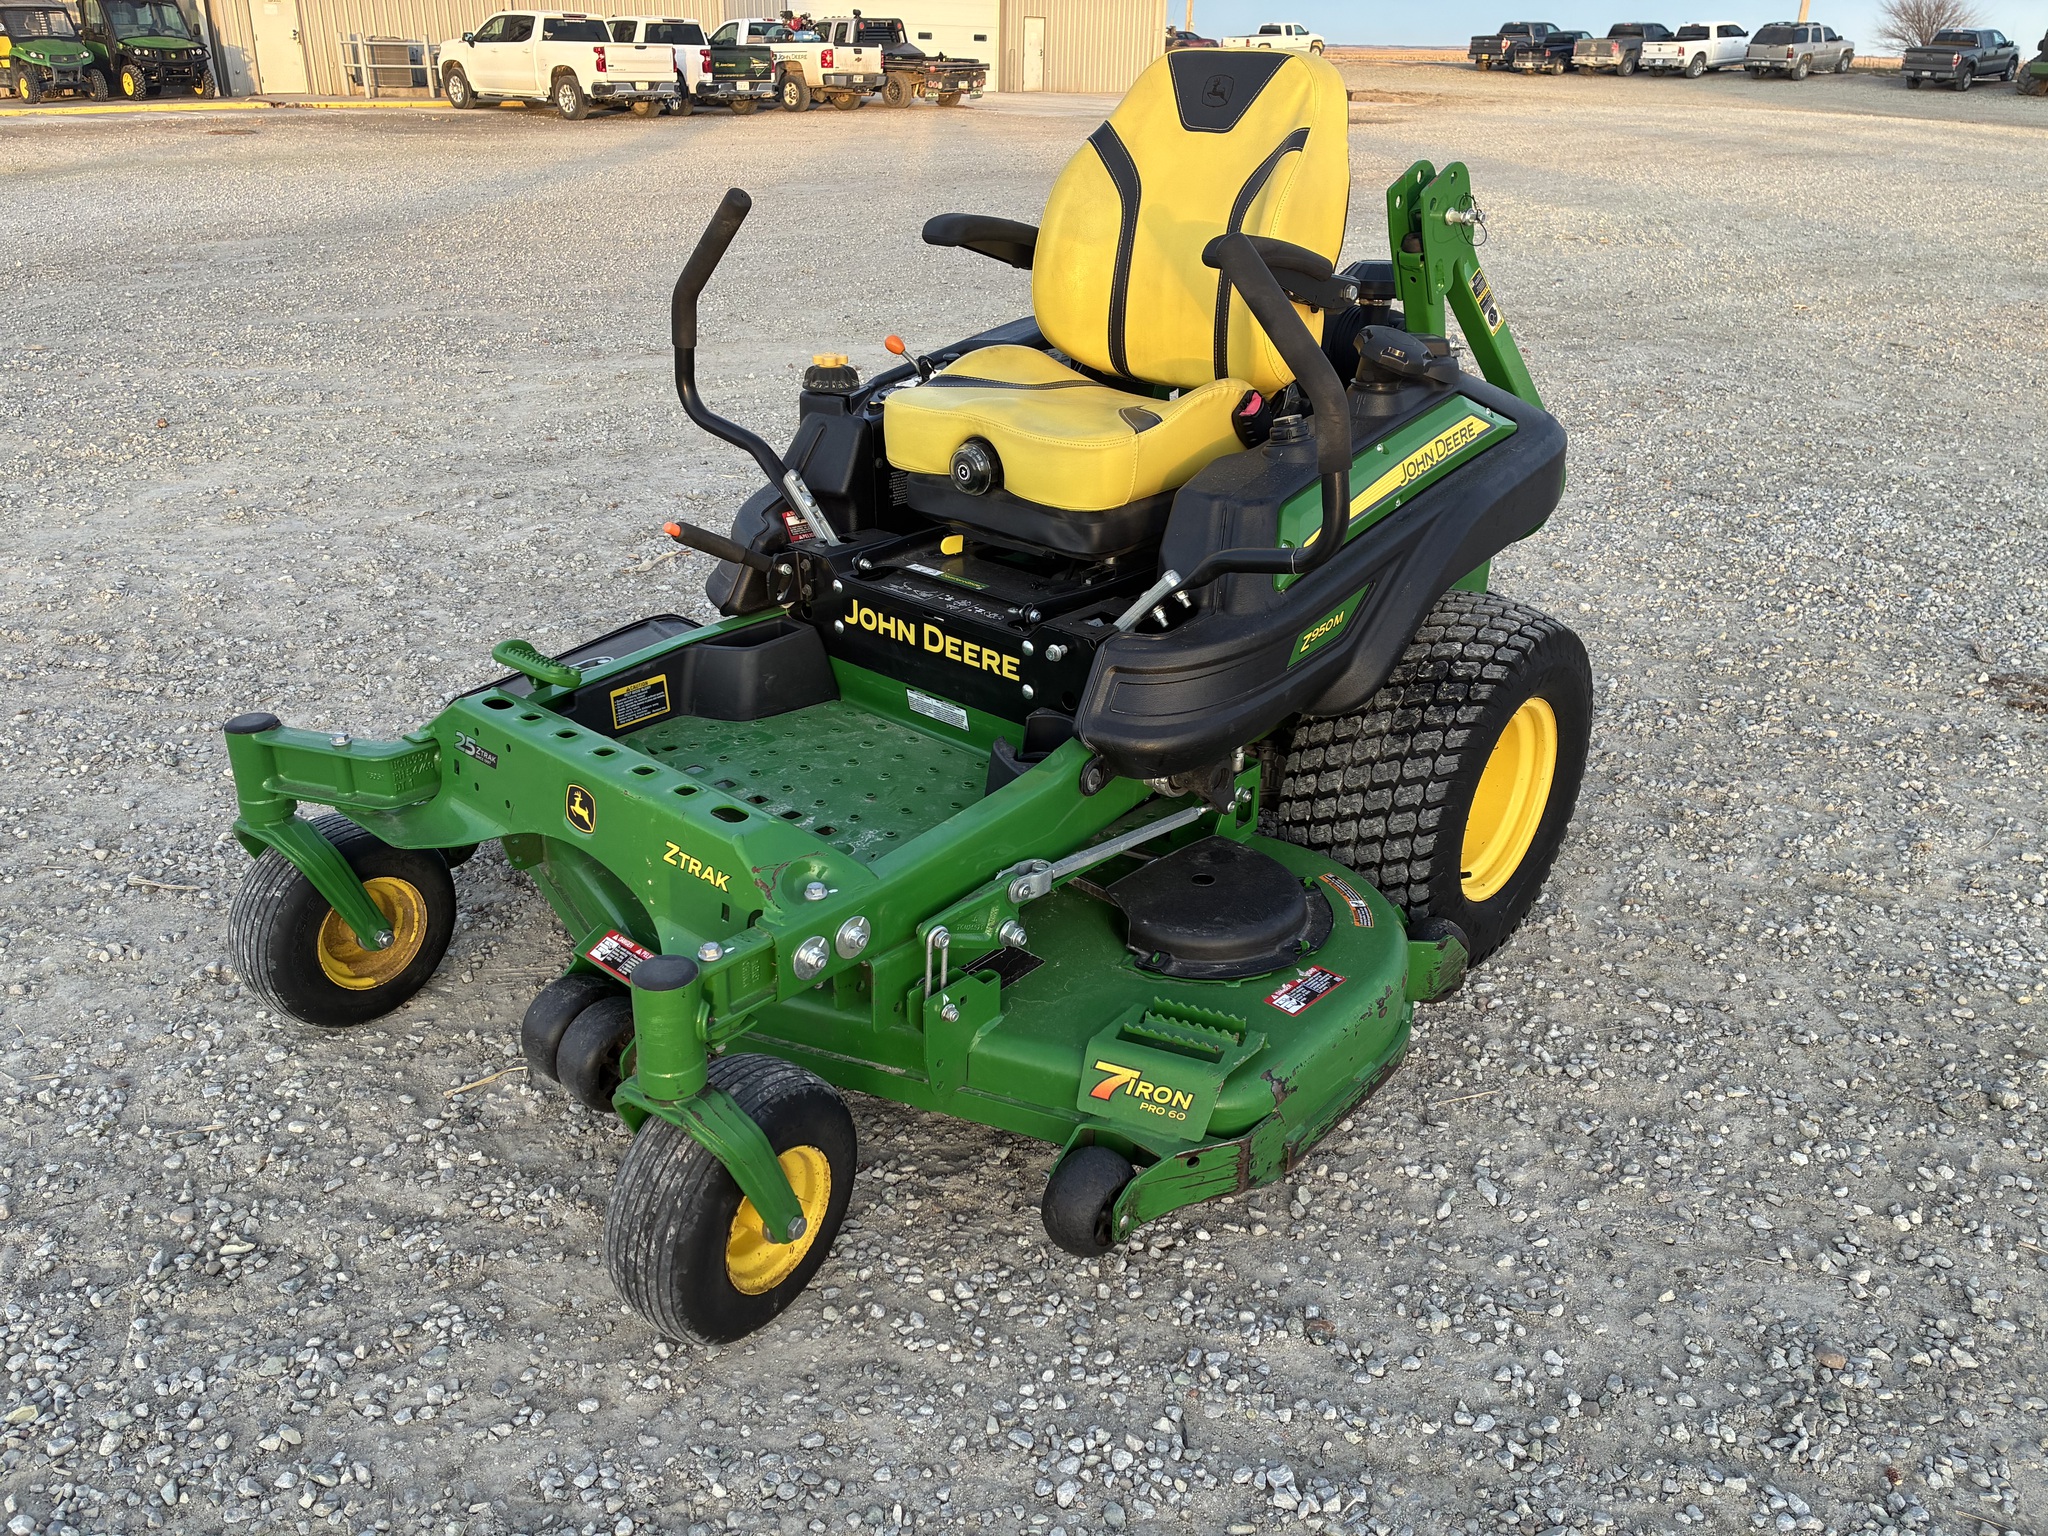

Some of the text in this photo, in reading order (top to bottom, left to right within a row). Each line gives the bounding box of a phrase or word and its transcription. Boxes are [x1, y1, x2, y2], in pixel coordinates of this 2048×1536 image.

[1400, 421, 1476, 484] JOHN DEERE
[844, 598, 916, 646] JOHN
[923, 622, 1021, 682] DEERE
[1299, 610, 1345, 654] Z950M
[454, 730, 497, 763] 25 ZTRAK
[662, 839, 732, 894] ZTRAK
[618, 936, 635, 949] DANGER
[1139, 1102, 1187, 1121] PRO 60
